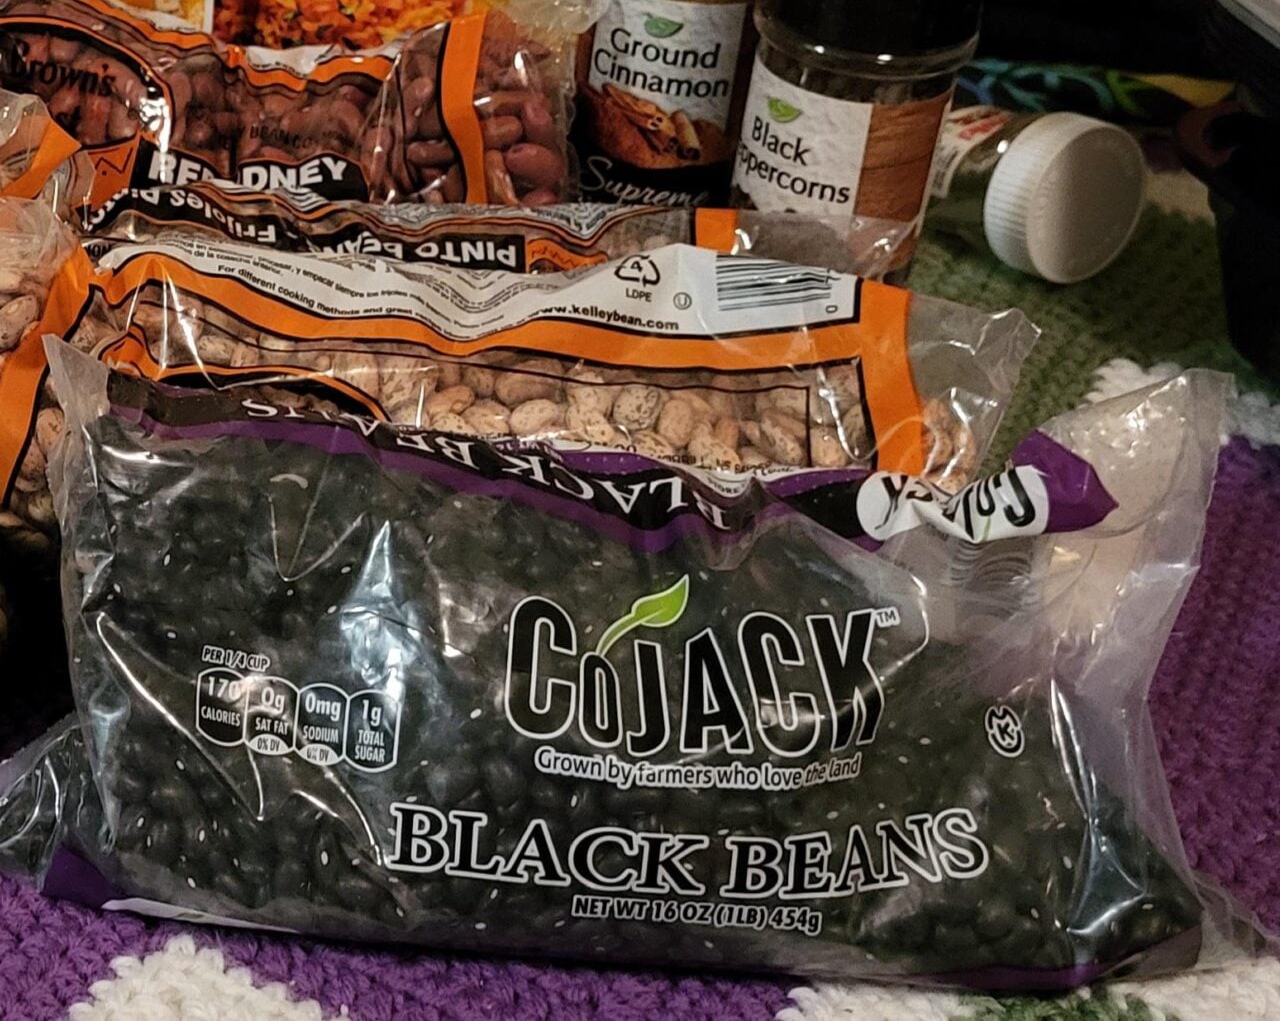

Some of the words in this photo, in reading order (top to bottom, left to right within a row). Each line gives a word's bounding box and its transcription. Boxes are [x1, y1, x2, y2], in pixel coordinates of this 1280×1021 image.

[610, 28, 721, 69] Ground
[594, 48, 729, 97] Cinnamon
[752, 115, 811, 166] Black
[243, 157, 347, 191] DNEY
[581, 156, 709, 207] Supreme
[739, 143, 850, 204] ppercorns
[415, 241, 517, 267] PINTO
[218, 265, 236, 273] For
[238, 268, 275, 291] different
[278, 284, 315, 307] cooking
[317, 301, 360, 315] methods
[626, 289, 652, 302] LDPE
[242, 399, 479, 469] BEAS
[490, 444, 730, 531] BLACK
[204, 647, 223, 664] PER
[225, 651, 246, 668] 1/4
[247, 655, 269, 670] CUP
[207, 676, 241, 701] 170
[261, 687, 285, 715] 0g
[201, 706, 241, 727] CALORIES
[305, 692, 341, 722] 0mg
[362, 699, 382, 726] 1g
[255, 717, 272, 731] SAT
[274, 720, 290, 735] FAT
[303, 725, 339, 743] SODIUM
[358, 729, 384, 746] TOTAL
[257, 736, 268, 750] 0%
[270, 737, 280, 752] DV
[306, 747, 318, 761] 0%
[319, 749, 329, 762] DV
[354, 747, 385, 763] SUGAR
[538, 749, 601, 776] Grown
[609, 756, 632, 786] by
[637, 762, 712, 786] farmers
[717, 765, 759, 786] who
[763, 763, 801, 787] love
[803, 761, 827, 784] the
[829, 755, 861, 779] land
[389, 803, 709, 896] BLACK
[725, 807, 989, 900] BEANS
[573, 896, 610, 917] NET
[613, 900, 650, 920] WT
[652, 901, 676, 921] 16
[682, 903, 713, 922] OZ
[771, 907, 820, 935] 454g
